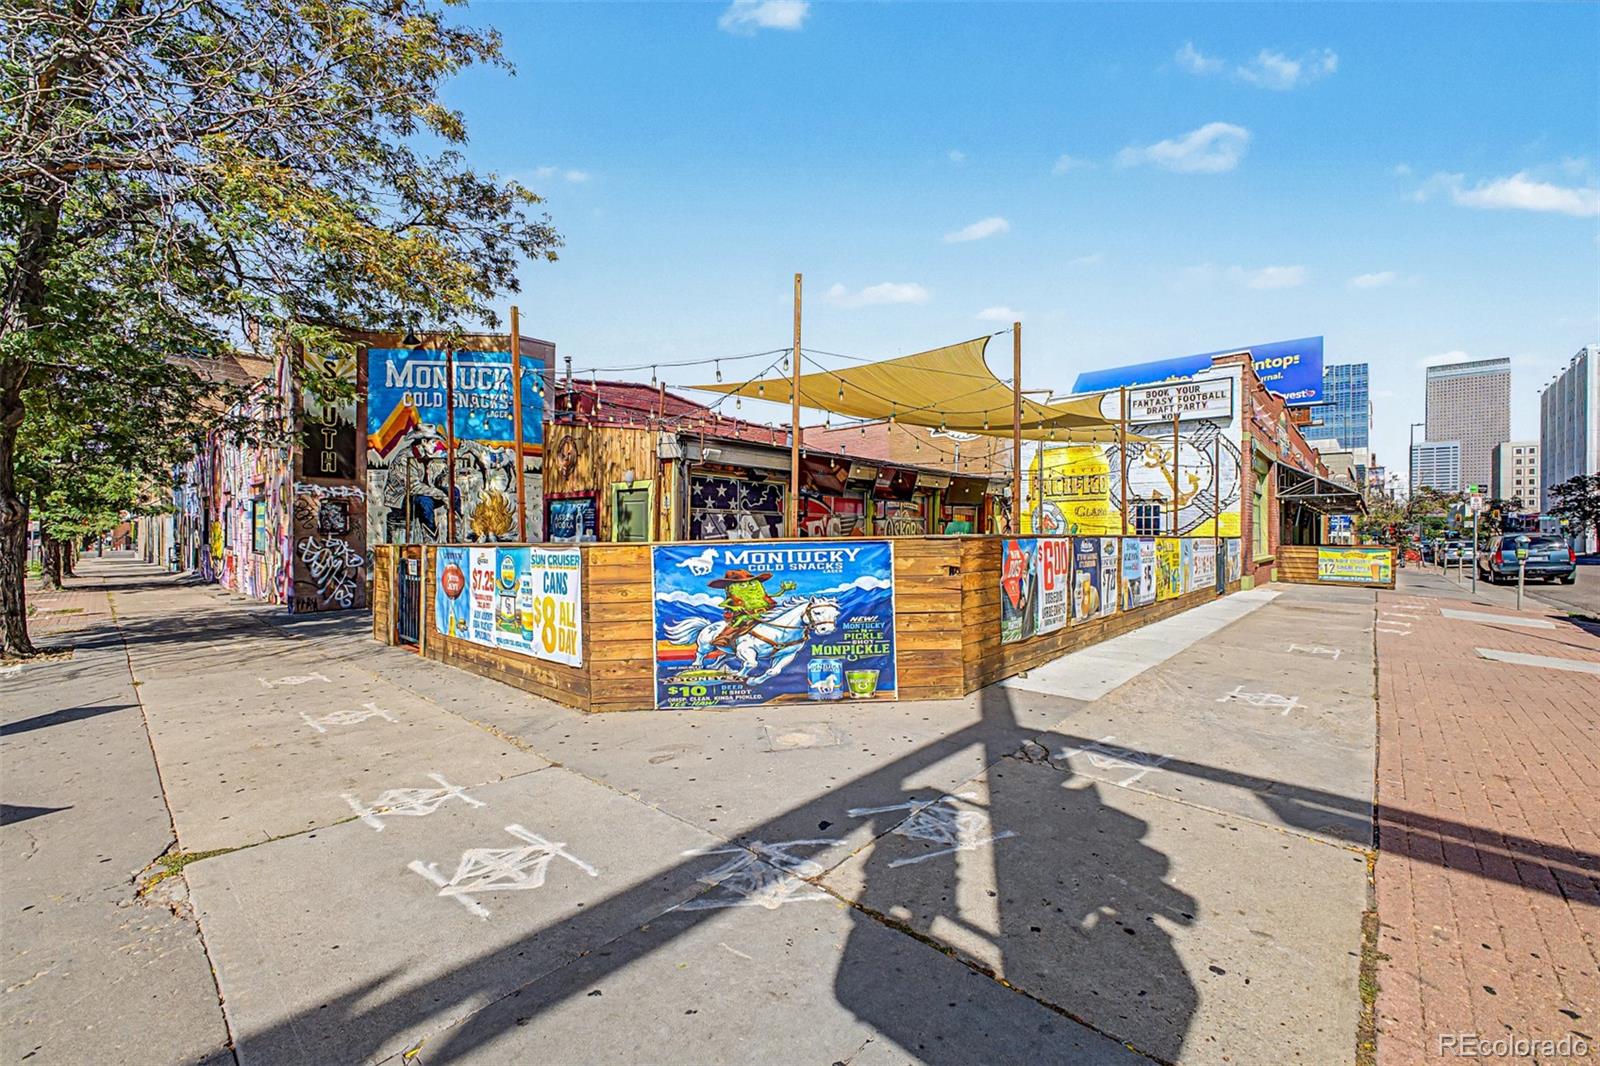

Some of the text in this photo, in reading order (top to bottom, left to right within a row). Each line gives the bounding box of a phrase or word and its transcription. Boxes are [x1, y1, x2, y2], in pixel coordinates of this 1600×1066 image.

[402, 391, 443, 408] COLD
[1133, 390, 1227, 408] FANTASY FOOTBALL
[1146, 385, 1201, 399] BOOK YOUR
[1147, 401, 1208, 415] DRAFT PARTY
[321, 360, 338, 472] SOUTH
[531, 553, 580, 566] SUN CRUISER
[724, 547, 862, 565] MONTUCKY
[748, 562, 844, 572] COLD SNACKS
[472, 567, 495, 593] $7.25
[543, 571, 568, 595] CANS
[559, 601, 577, 629] ALL
[849, 615, 880, 623] NEW!
[533, 595, 557, 654] $8
[842, 622, 886, 630] MONTUCKY
[558, 627, 578, 656] DAY
[843, 632, 884, 640] PICKLE
[811, 643, 891, 656] MONPICKLE
[667, 685, 707, 697] $10
